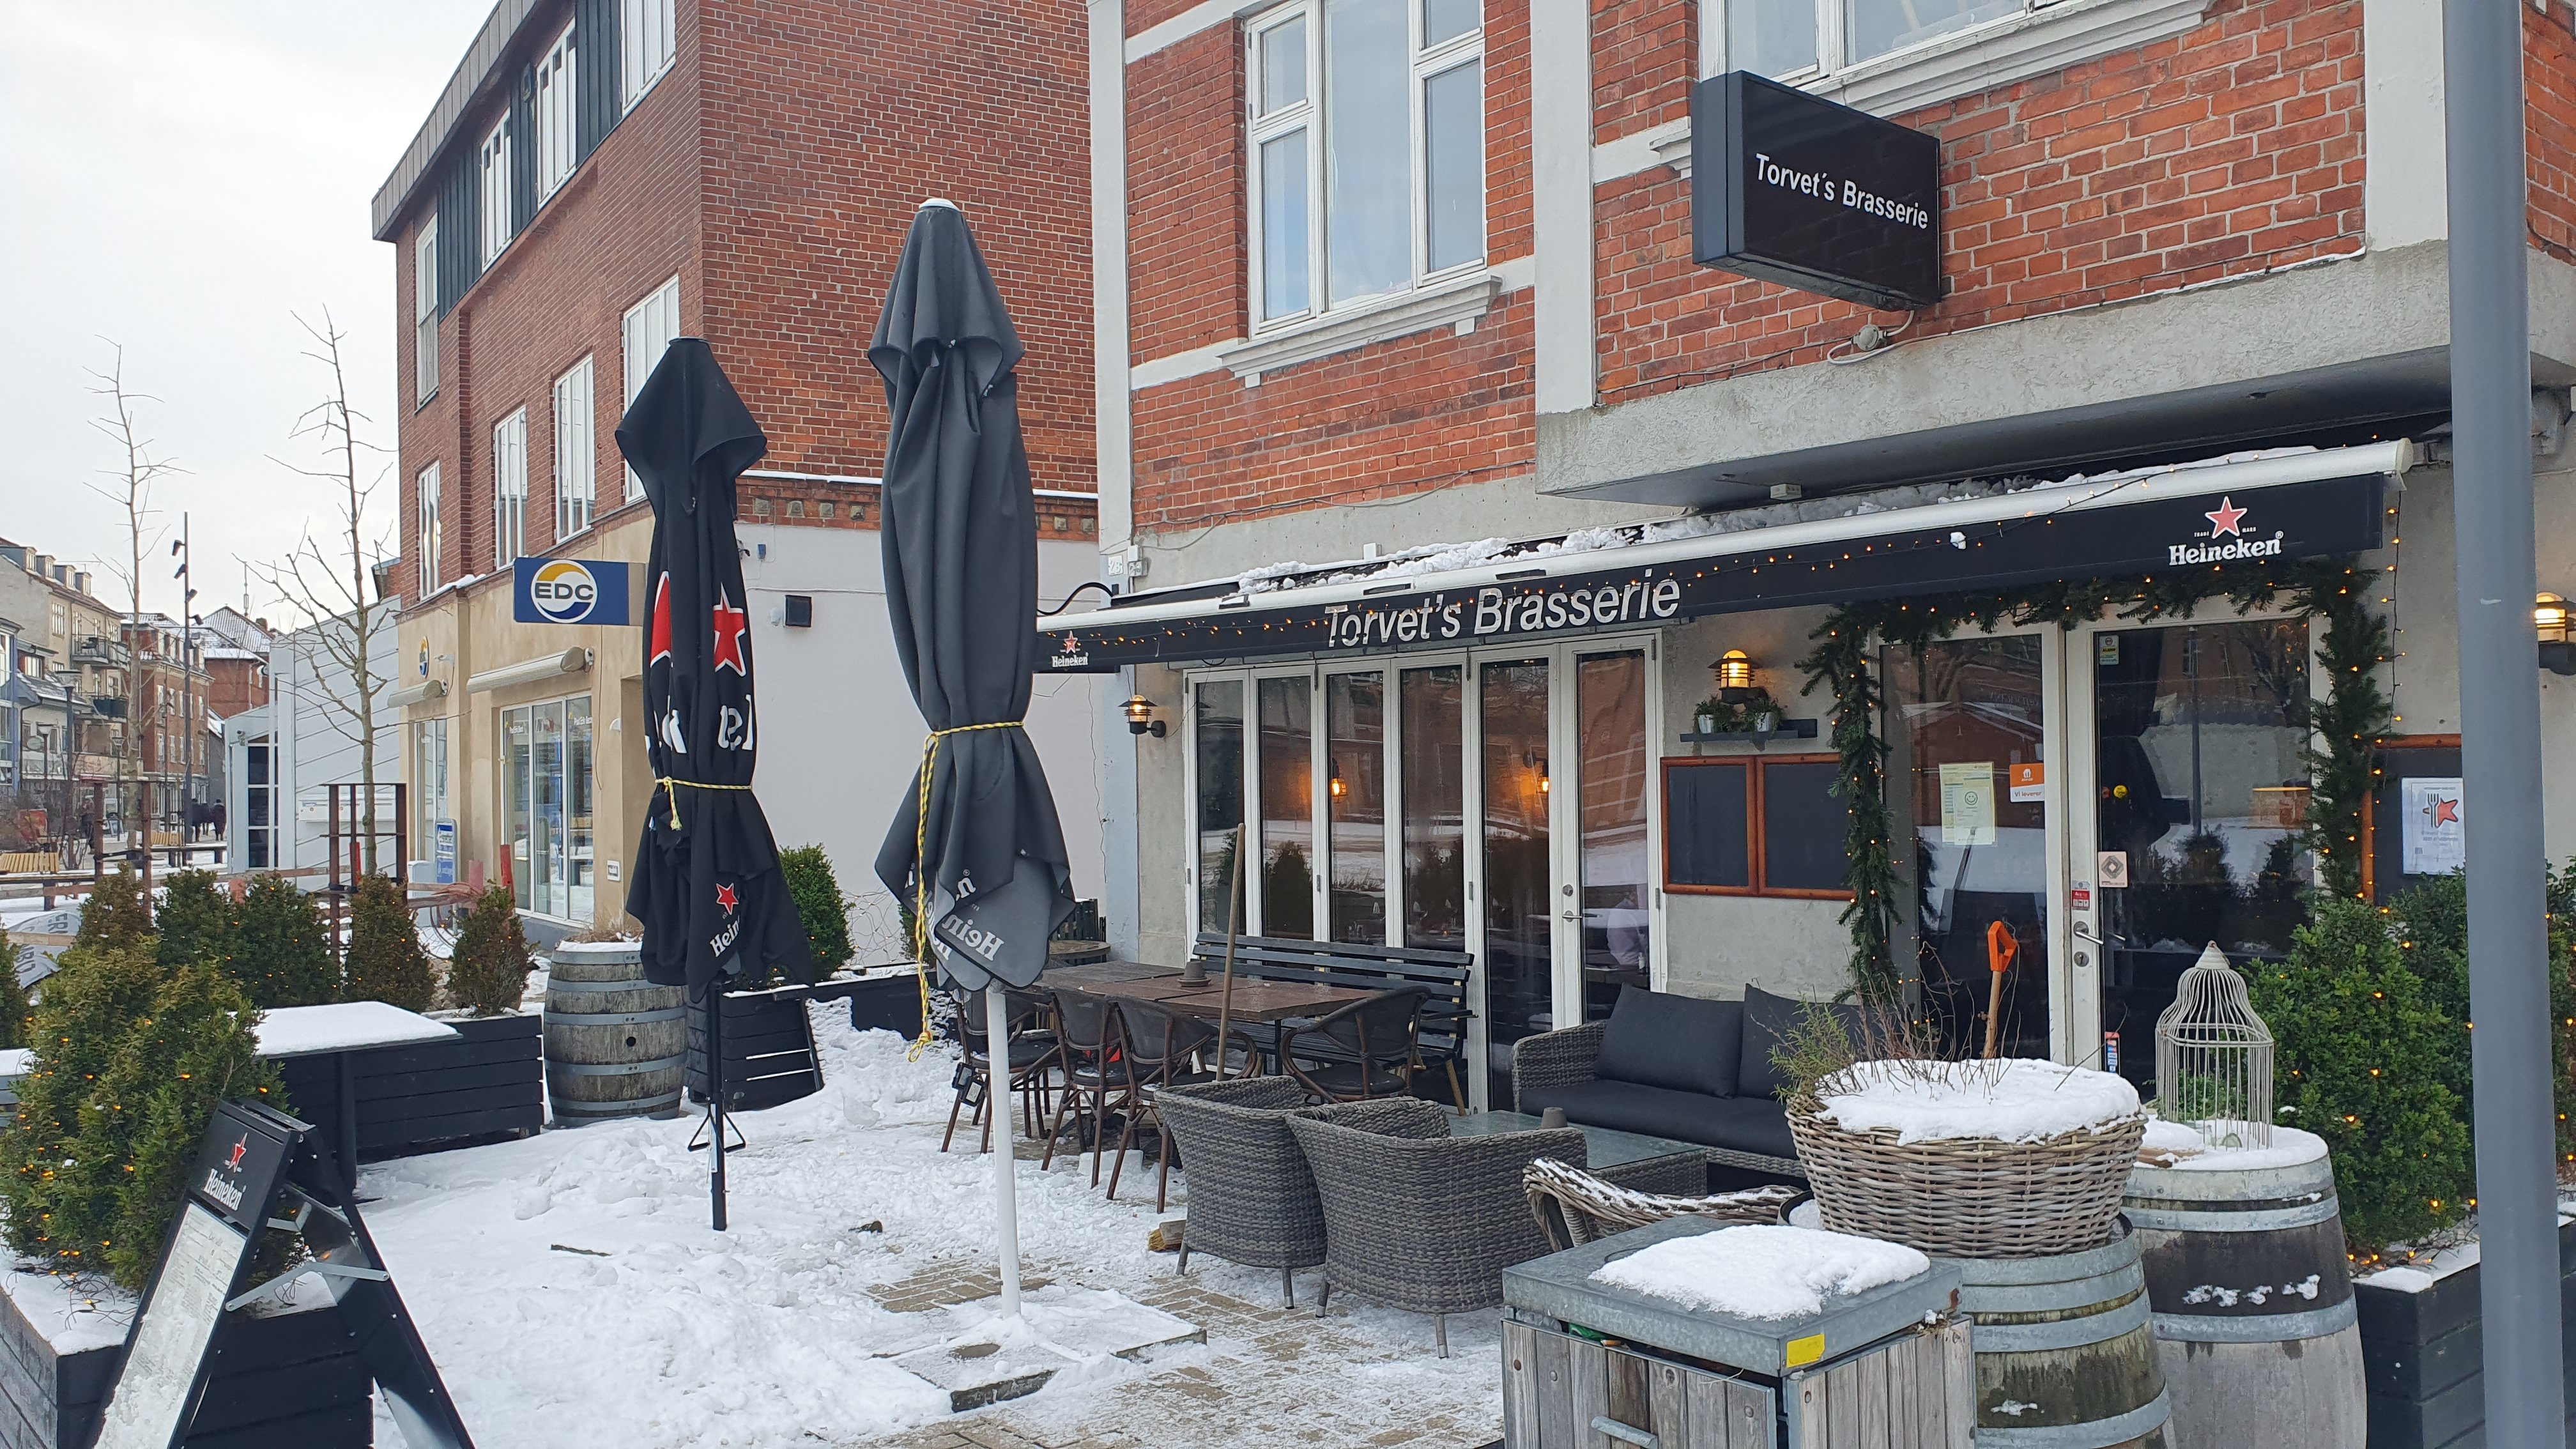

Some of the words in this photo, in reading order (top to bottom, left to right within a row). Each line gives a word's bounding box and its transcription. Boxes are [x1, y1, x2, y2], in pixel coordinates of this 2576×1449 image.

[1843, 180, 1929, 230] Brasserie
[535, 582, 594, 601] EDC
[1473, 567, 1681, 635] Brasserie
[1051, 654, 1089, 668] Heineken
[203, 1168, 243, 1211] Heineken
